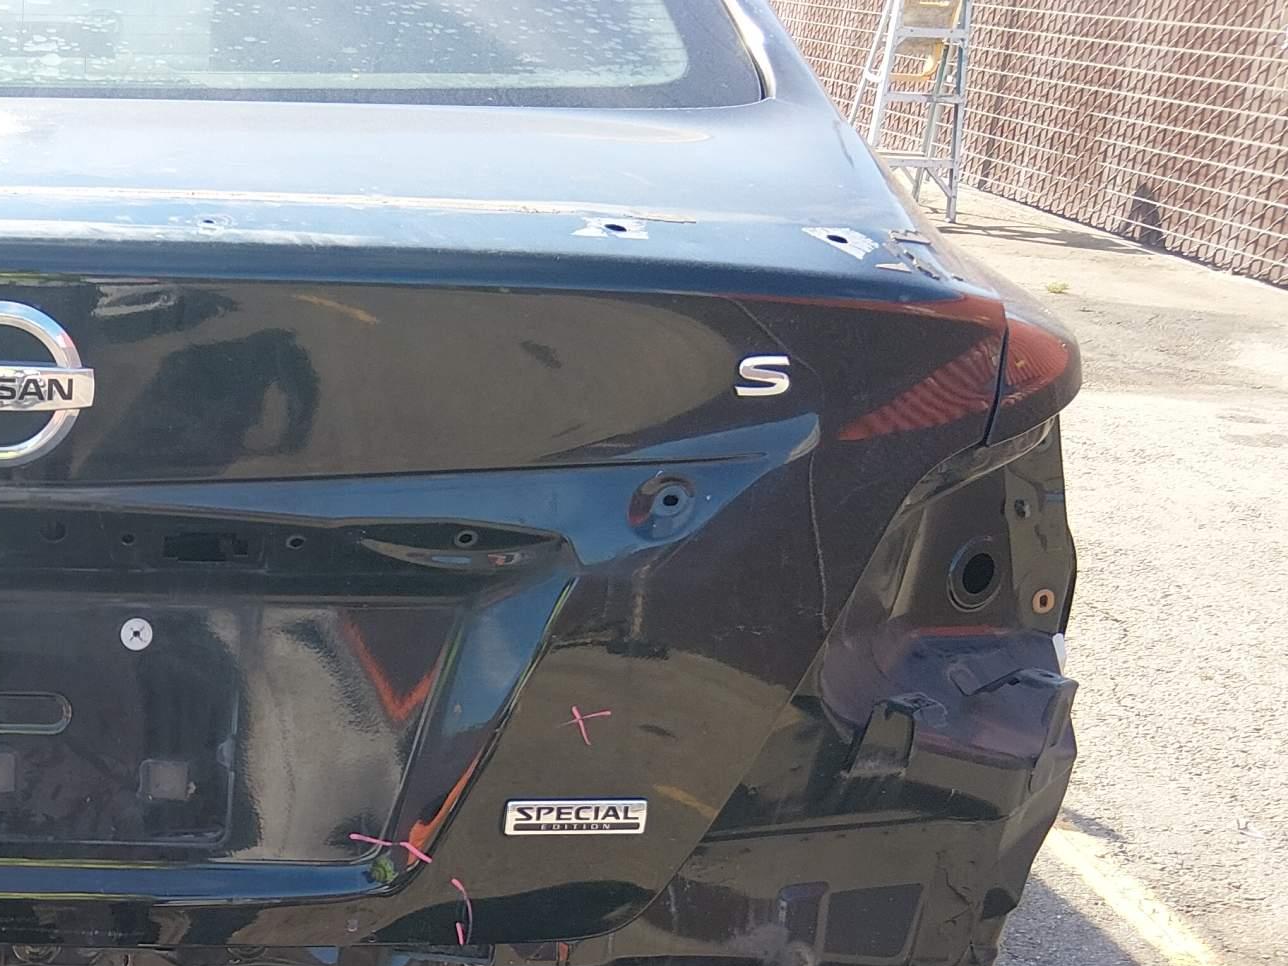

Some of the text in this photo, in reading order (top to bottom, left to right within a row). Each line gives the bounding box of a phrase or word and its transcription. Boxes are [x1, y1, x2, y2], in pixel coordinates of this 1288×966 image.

[734, 355, 791, 397] S
[514, 805, 640, 822] SPECIAL
[540, 822, 612, 831] EDITION
